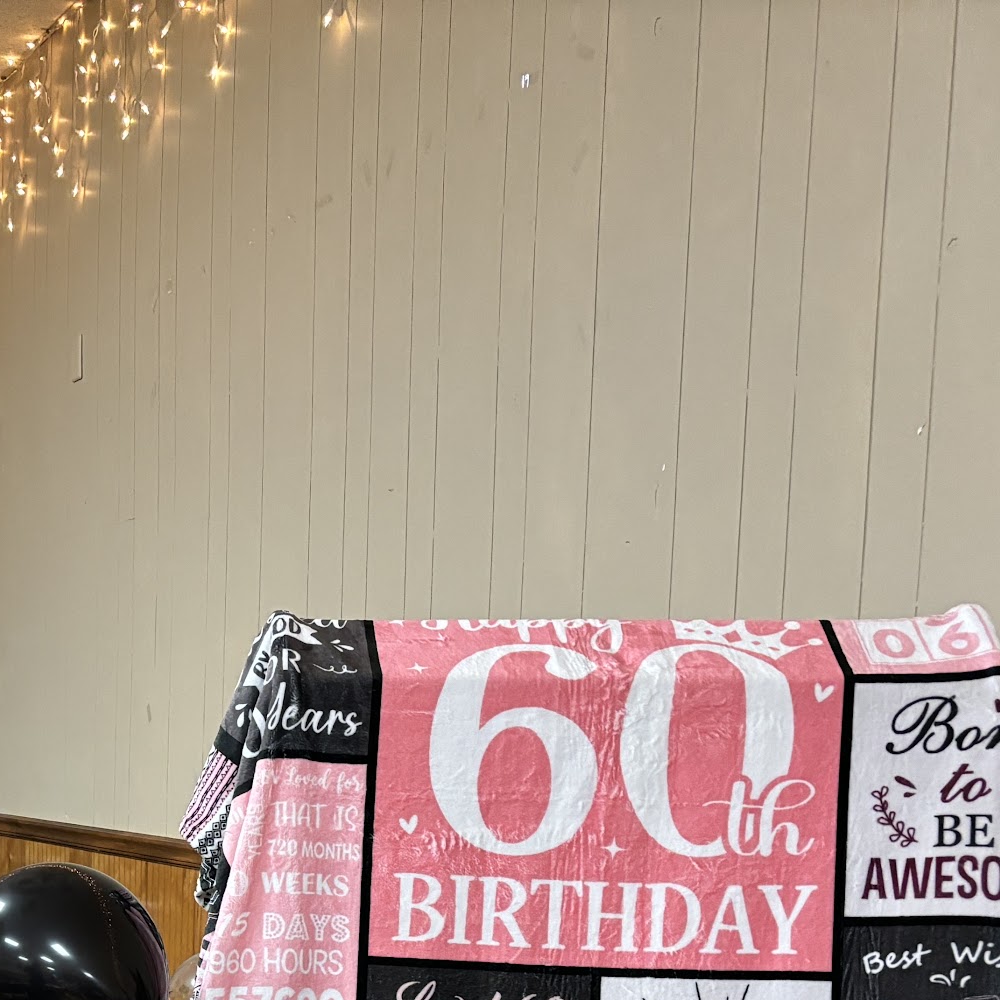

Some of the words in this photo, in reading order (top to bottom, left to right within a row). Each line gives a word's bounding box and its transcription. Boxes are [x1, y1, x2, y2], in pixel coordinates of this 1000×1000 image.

[286, 767, 332, 790] Loved
[336, 771, 363, 794] for
[940, 763, 992, 804] to
[271, 800, 328, 829] THAT
[333, 804, 359, 832] IS
[933, 814, 995, 848] BE
[268, 839, 298, 858] 720
[301, 841, 361, 862] MONTHS
[261, 871, 350, 898] WEEKS
[263, 912, 350, 943] DAYS
[391, 871, 818, 956] BIRTHDAY
[263, 948, 344, 976] HOURS
[863, 943, 933, 975] Best
